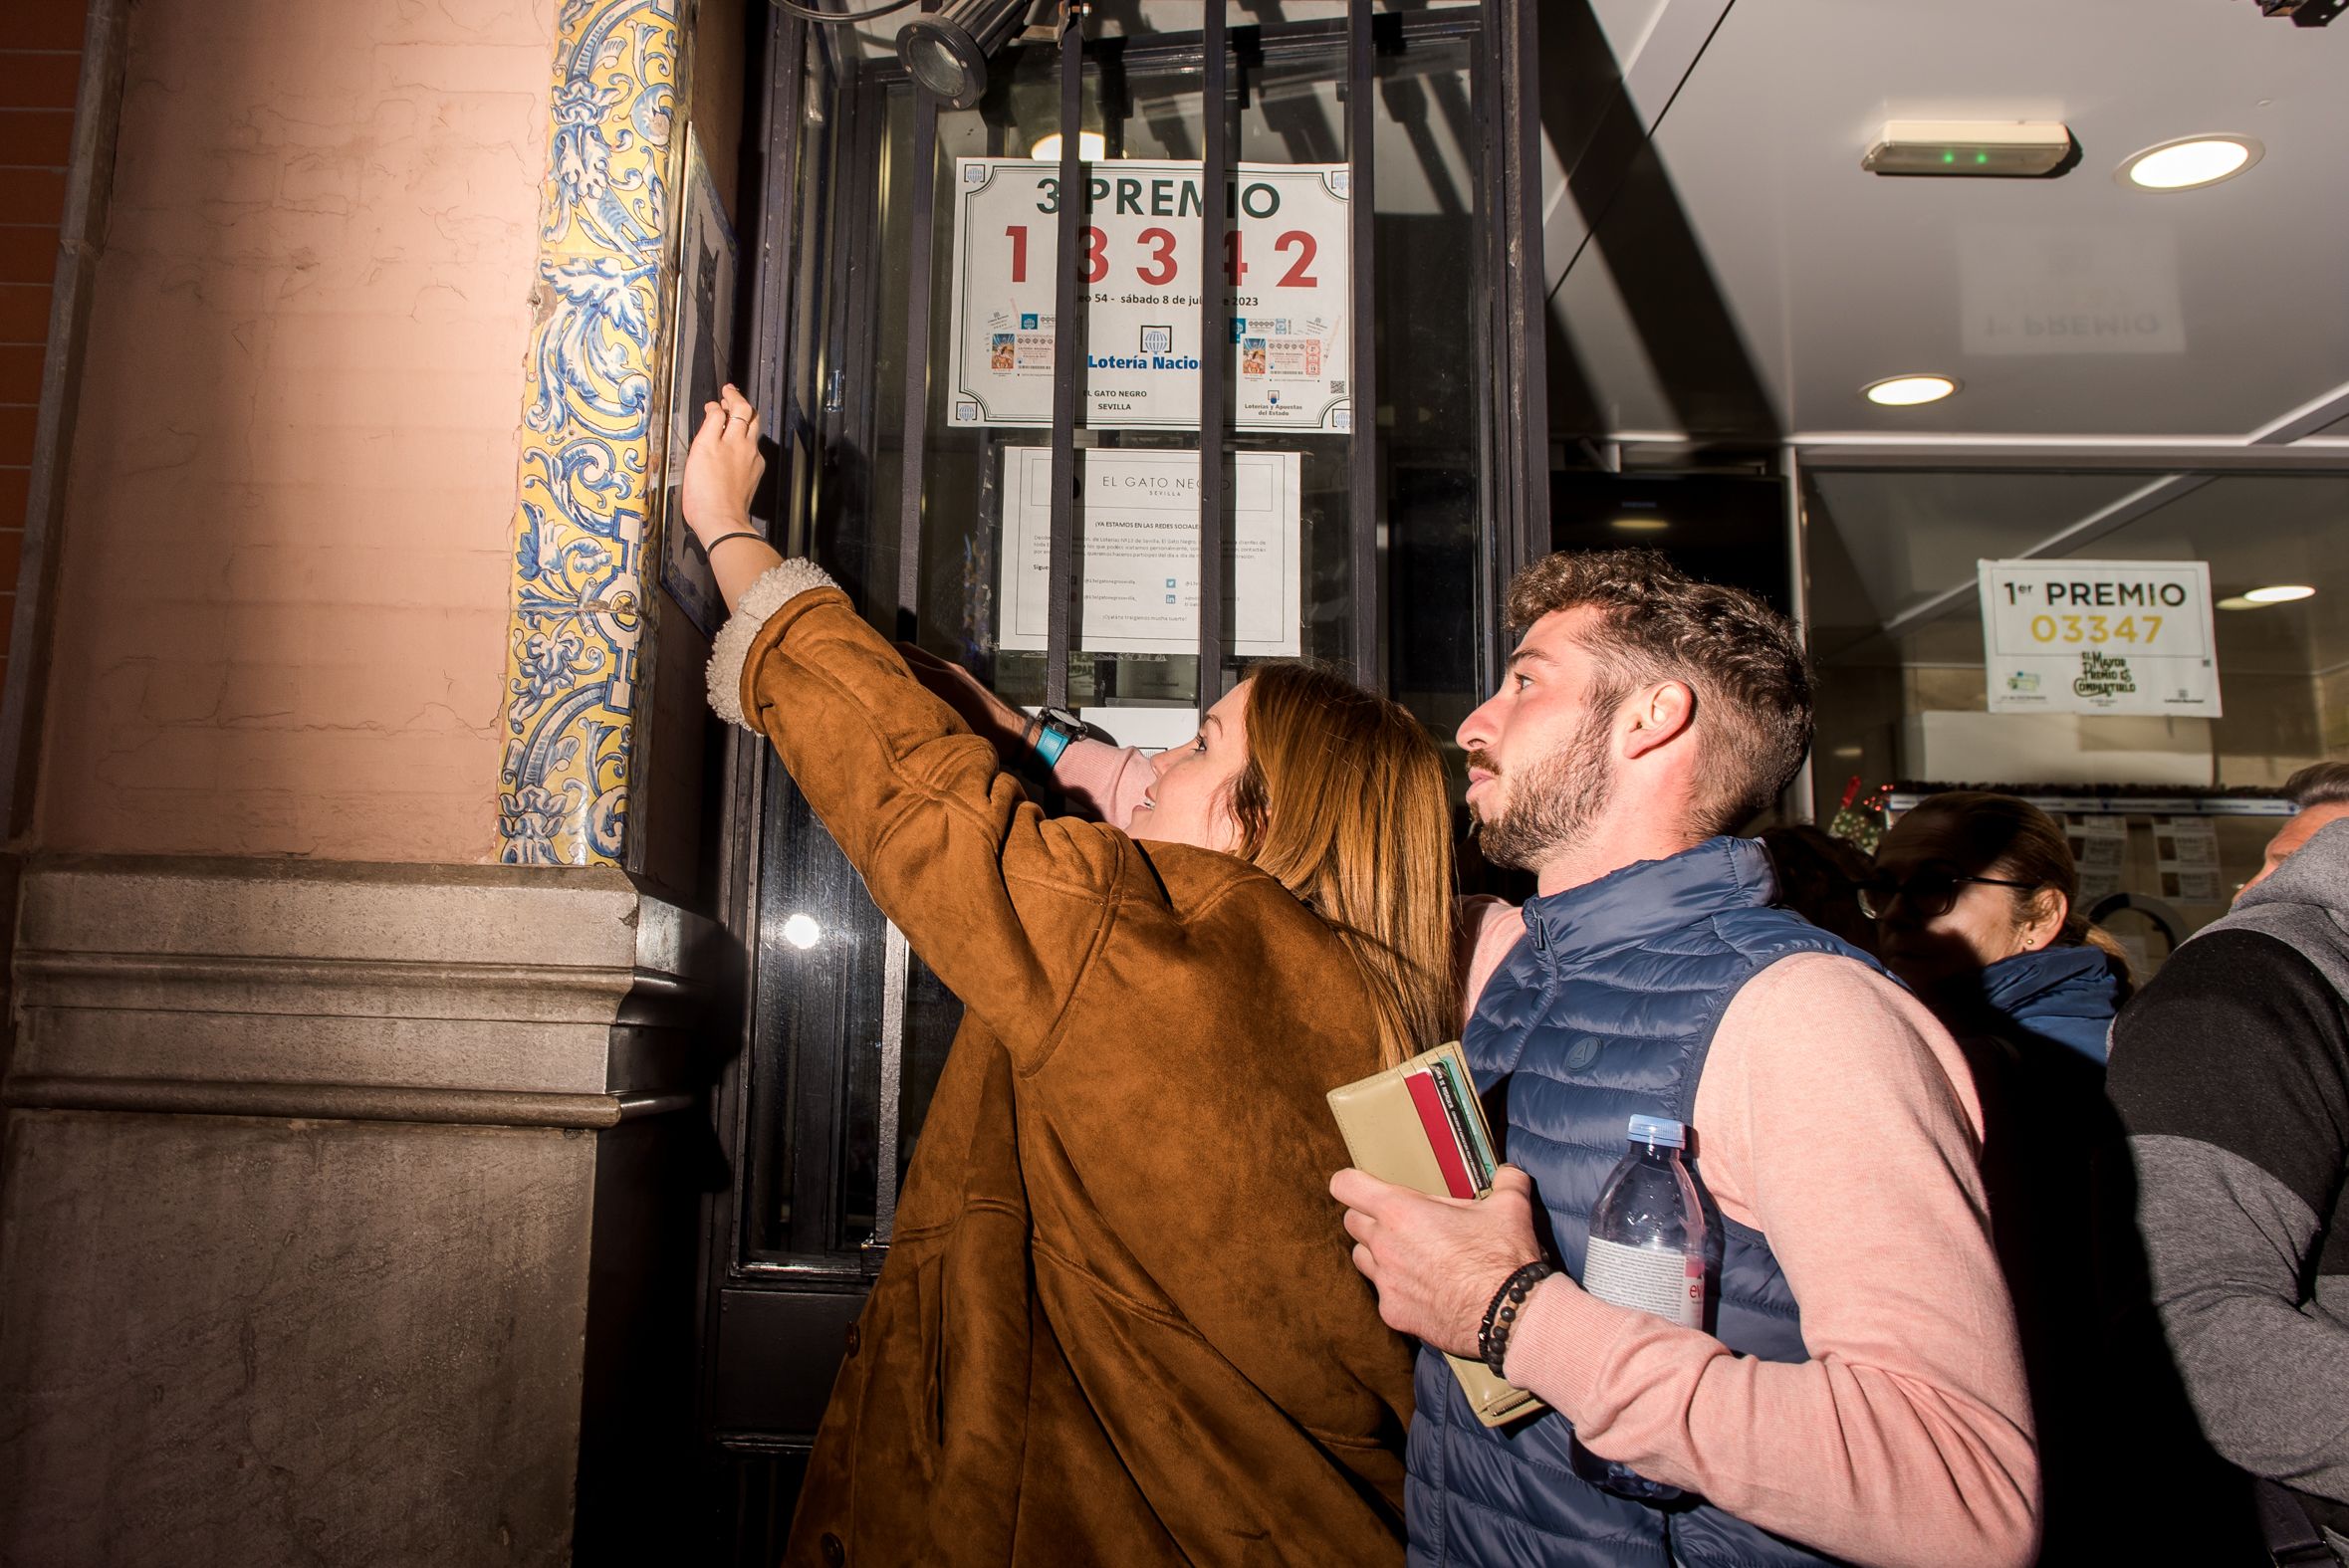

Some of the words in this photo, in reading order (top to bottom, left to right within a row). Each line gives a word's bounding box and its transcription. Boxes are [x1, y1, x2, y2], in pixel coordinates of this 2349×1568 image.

[1084, 178, 1281, 219] PREMIO
[1094, 294, 1107, 304] 54
[1120, 294, 1159, 305] sábado
[1162, 296, 1169, 305] 8
[1172, 295, 1185, 305] de
[1232, 298, 1259, 307] 2023
[1087, 354, 1148, 369] Lotería
[1152, 355, 1202, 369] Nacio
[1102, 476, 1117, 487] EL
[1125, 477, 1168, 488] GATO
[1176, 478, 1231, 491] NEO
[2047, 582, 2187, 606] PREMIO
[2030, 614, 2164, 643] 03347
